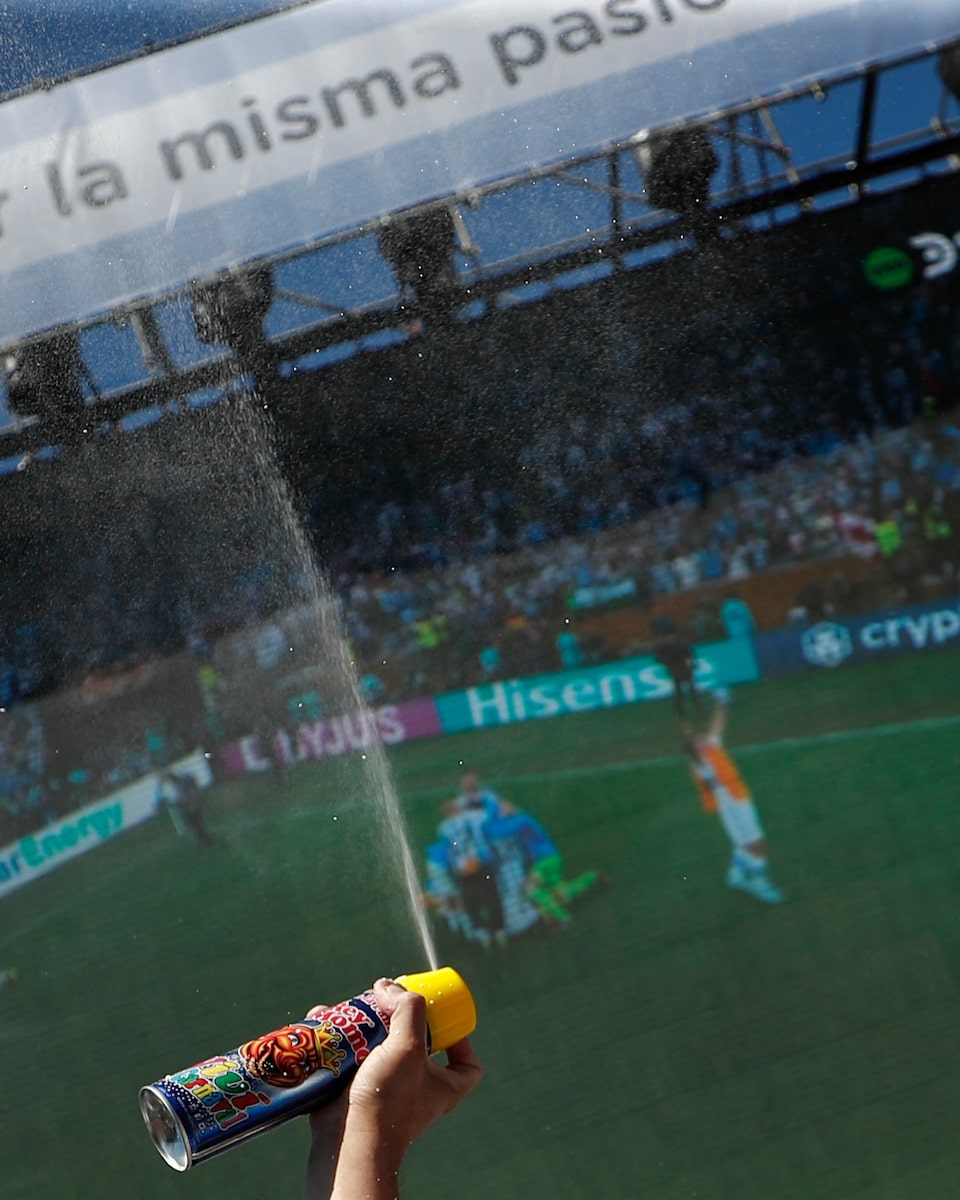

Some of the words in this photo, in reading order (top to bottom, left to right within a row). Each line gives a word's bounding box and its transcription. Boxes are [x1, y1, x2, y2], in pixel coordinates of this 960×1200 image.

[44, 160, 129, 217] la
[159, 48, 462, 181] misma
[489, 0, 730, 85] pasi
